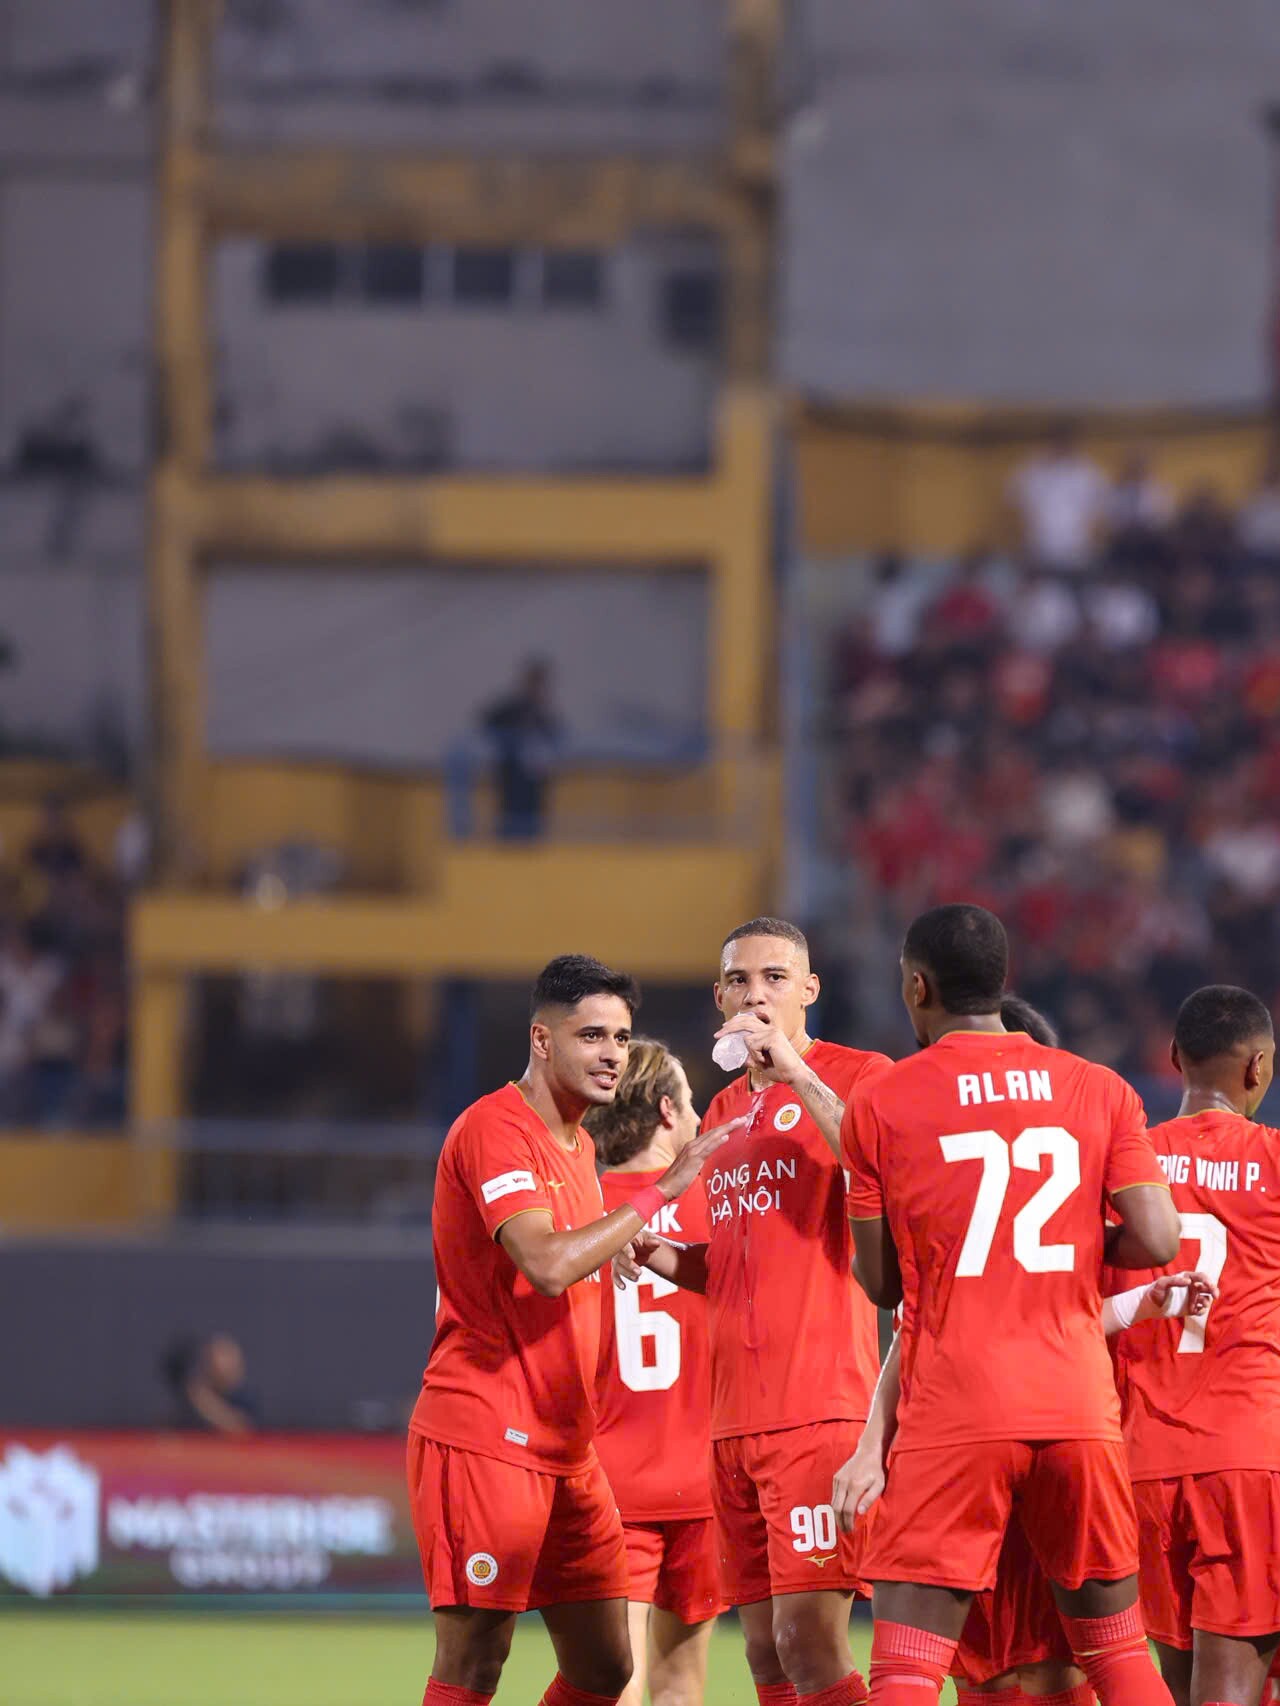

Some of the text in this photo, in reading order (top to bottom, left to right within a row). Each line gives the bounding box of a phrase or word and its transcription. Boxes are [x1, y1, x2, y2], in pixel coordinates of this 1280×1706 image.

[957, 1070, 1053, 1106] ALAN
[756, 1158, 796, 1181] AN
[1196, 1157, 1239, 1191] VINH
[1245, 1162, 1266, 1192] P.
[710, 1185, 780, 1226] HÀ NỘI
[938, 1126, 1081, 1277] 72
[612, 1265, 682, 1392] 6
[790, 1504, 837, 1553] 90
